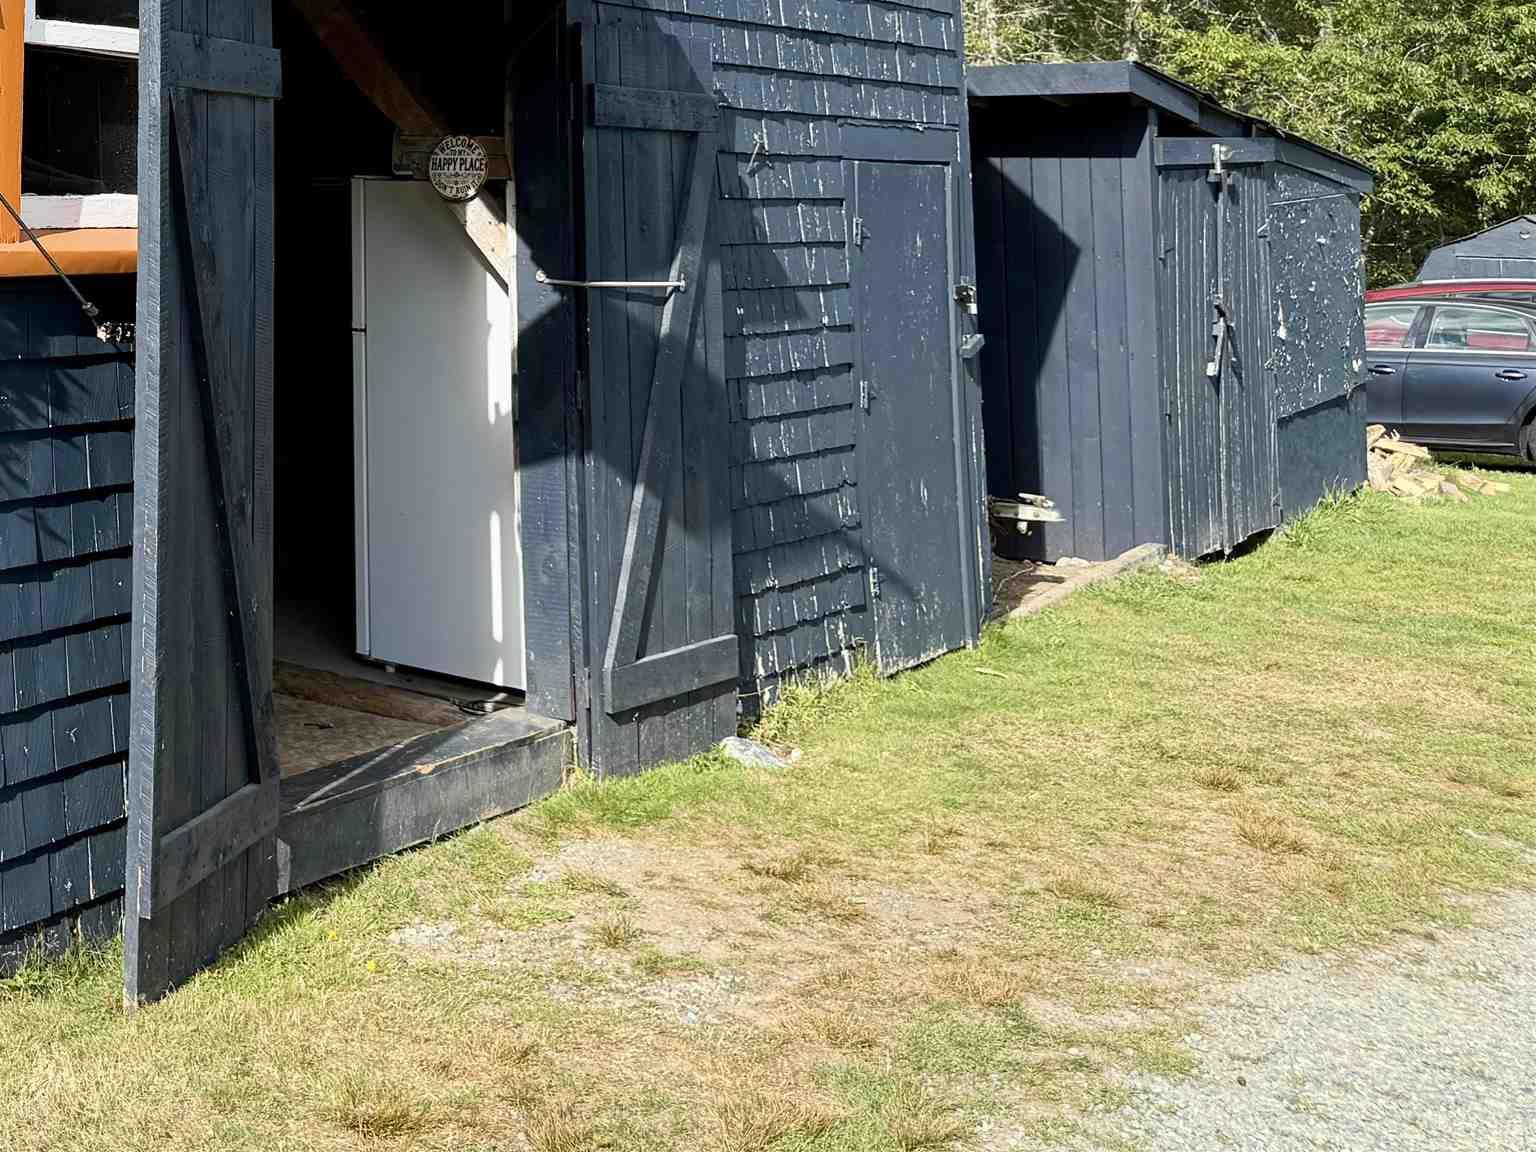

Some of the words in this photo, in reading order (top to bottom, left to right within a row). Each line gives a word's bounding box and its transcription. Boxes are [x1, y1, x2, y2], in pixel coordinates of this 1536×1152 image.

[438, 136, 480, 154] WELCOME
[431, 157, 458, 171] HAPPY
[459, 157, 484, 171] PLACE
[455, 183, 472, 195] RUIN
